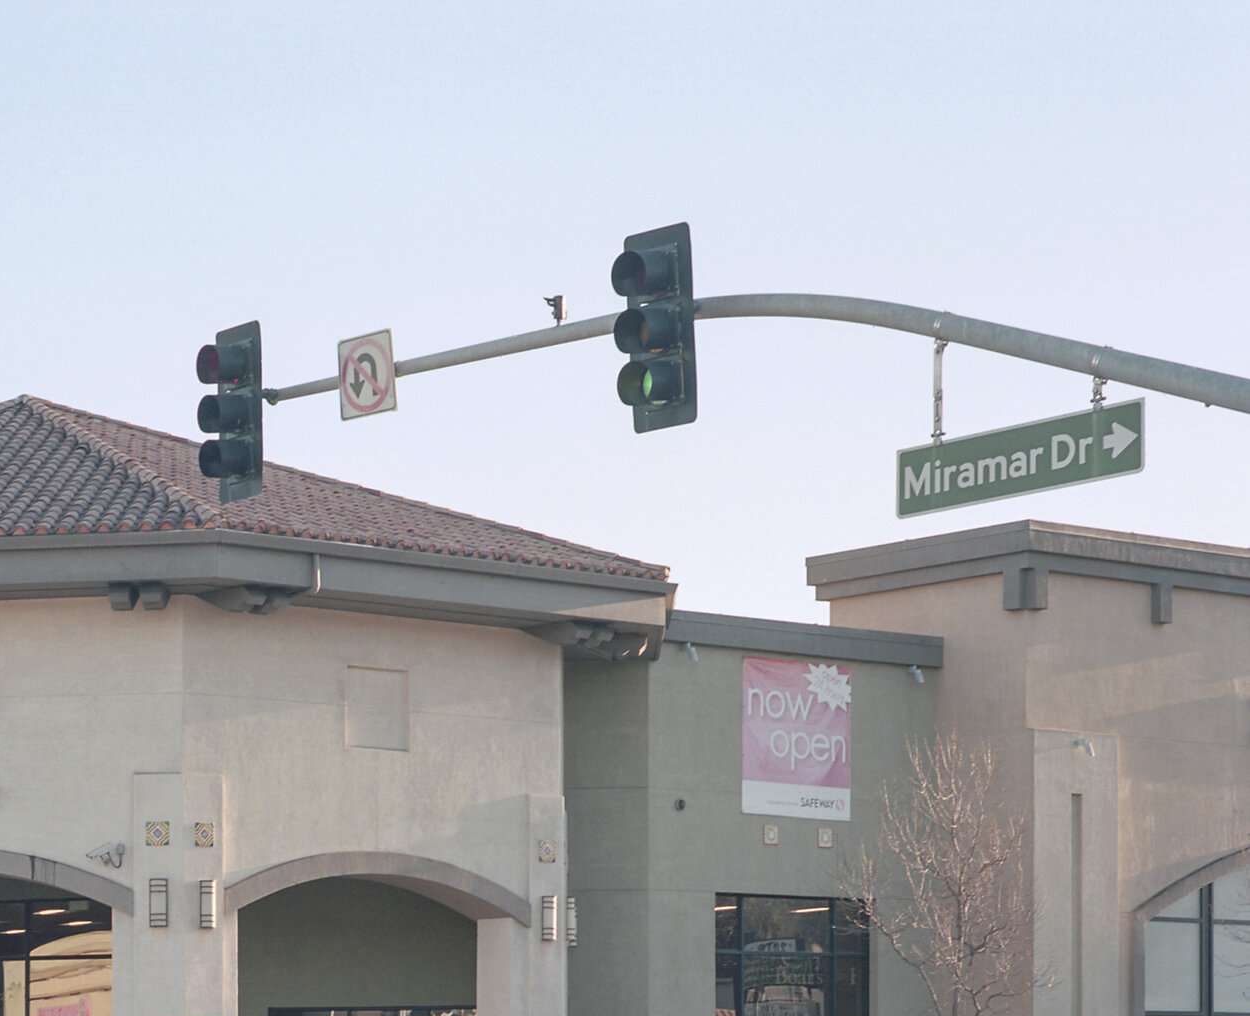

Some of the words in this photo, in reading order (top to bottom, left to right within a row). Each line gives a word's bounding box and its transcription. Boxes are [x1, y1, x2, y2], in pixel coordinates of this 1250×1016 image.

[903, 447, 1044, 500] Miramar
[1051, 433, 1094, 471] Dr
[747, 687, 814, 721] now
[770, 729, 847, 770] open
[800, 797, 835, 809] SAFEWAY
